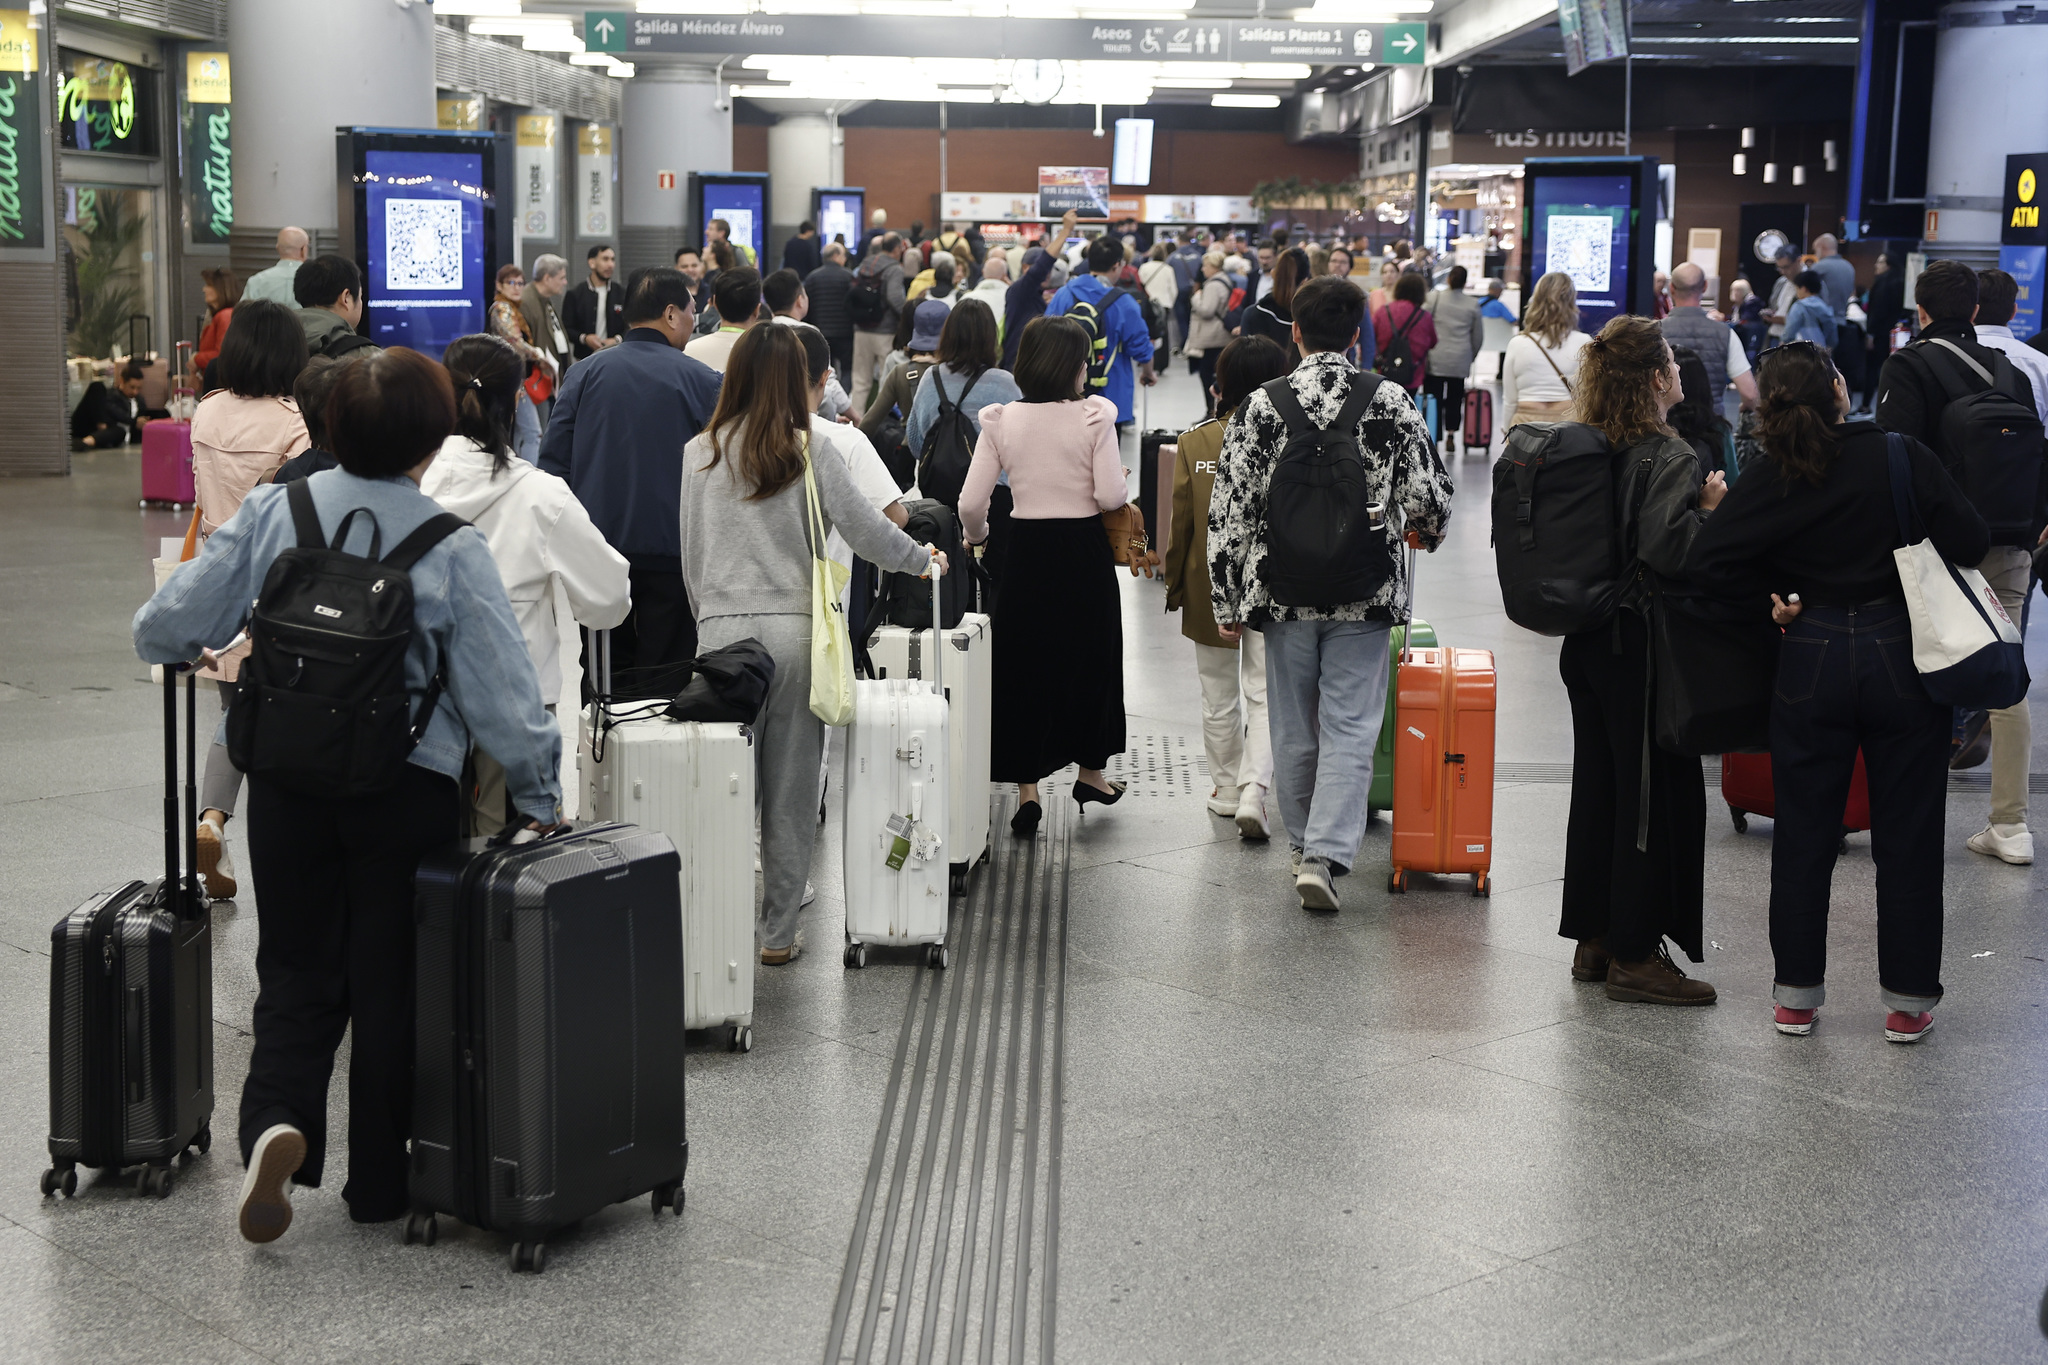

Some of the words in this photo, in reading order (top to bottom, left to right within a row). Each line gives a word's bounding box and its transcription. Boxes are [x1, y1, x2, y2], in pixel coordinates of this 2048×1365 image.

[634, 19, 678, 34] Salida
[682, 18, 737, 35] Méndez
[740, 19, 785, 35] Álvaro
[1091, 26, 1132, 40] Aseos
[1239, 27, 1286, 42] Salidas
[1288, 29, 1331, 42] Planta
[1333, 30, 1344, 42] 1
[203, 107, 233, 237] natura
[2010, 206, 2040, 228] ATM
[1195, 460, 1218, 474] PE
